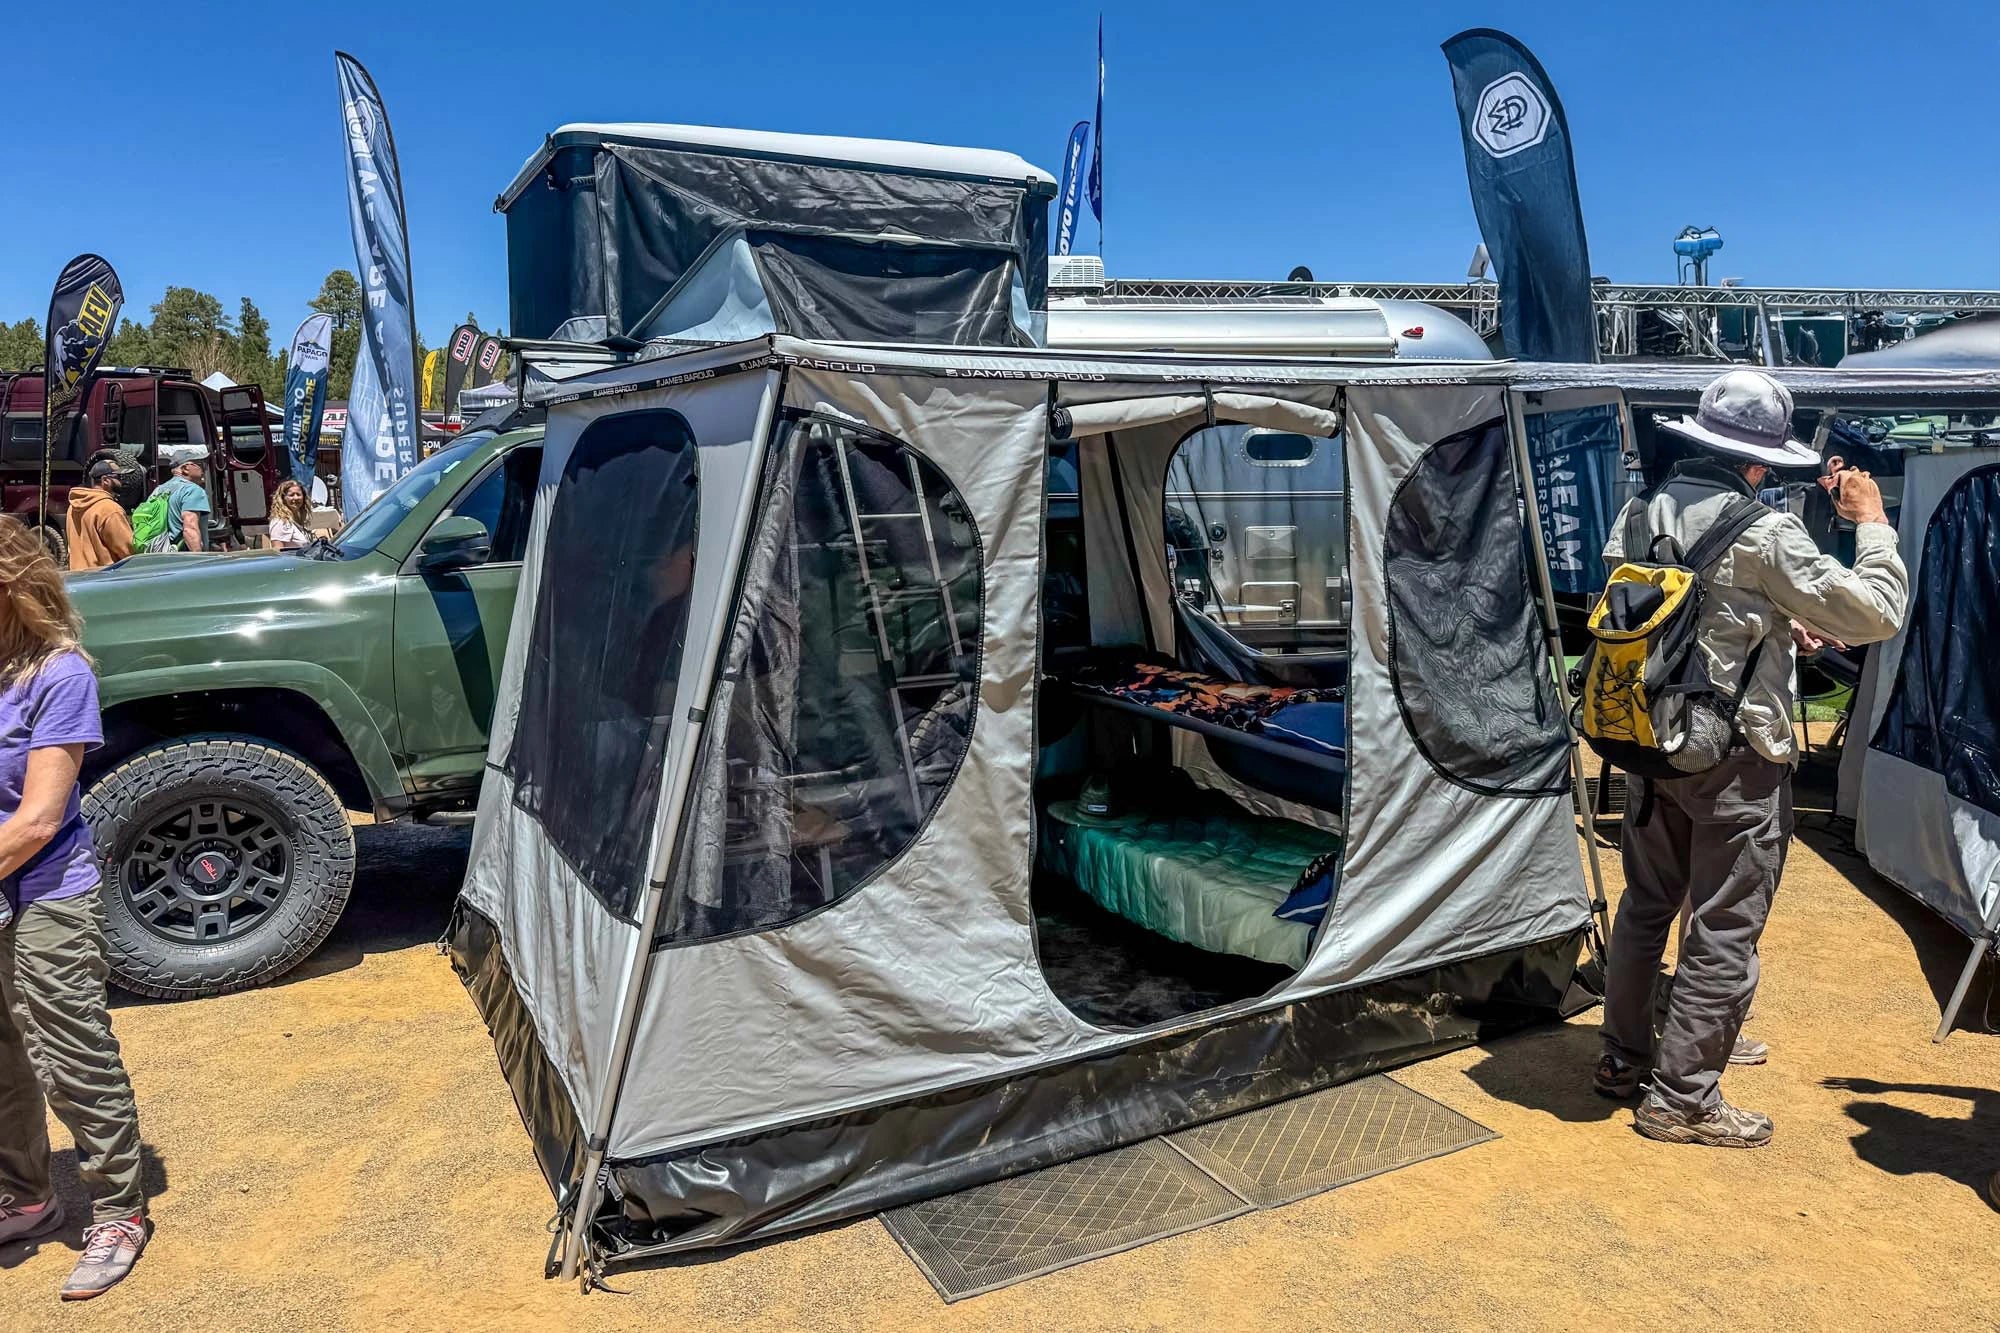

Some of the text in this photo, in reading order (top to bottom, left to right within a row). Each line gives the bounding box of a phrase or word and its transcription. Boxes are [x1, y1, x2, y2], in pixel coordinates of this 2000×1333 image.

[1059, 211, 1073, 256] OYO
[80, 287, 108, 337] AEV
[297, 345, 328, 357] PAPAGO
[456, 333, 470, 357] ARB
[482, 344, 496, 366] ARB
[747, 355, 876, 373] JAMES BAROUD
[961, 370, 1105, 381] JAMES BAROUD
[661, 369, 715, 386] JAMES BAROUD
[291, 388, 305, 451] BUILT TO
[299, 377, 317, 465] ADVENTURE
